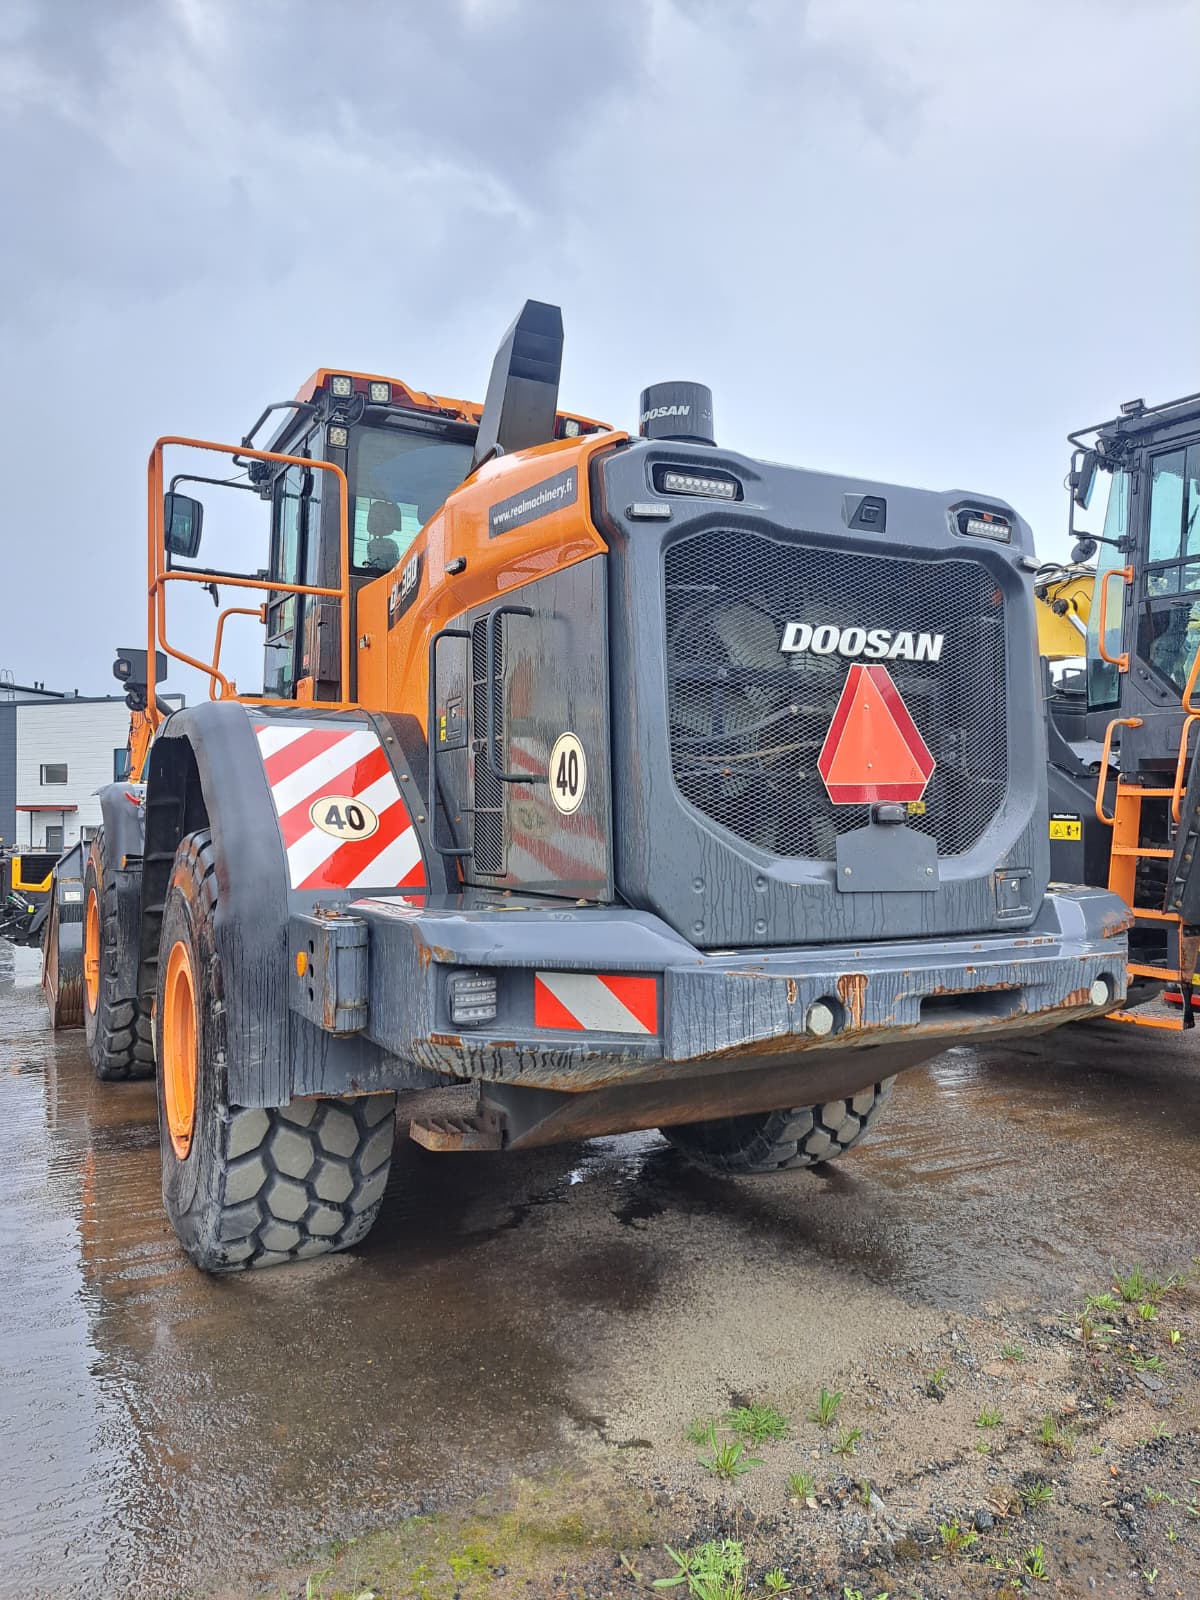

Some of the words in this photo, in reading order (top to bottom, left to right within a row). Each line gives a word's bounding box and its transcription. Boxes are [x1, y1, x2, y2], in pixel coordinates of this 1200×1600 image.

[493, 478, 573, 526] www.realmachinery.fi
[780, 622, 945, 662] DOOSAN
[556, 749, 579, 797] 40
[324, 804, 366, 831] 40
